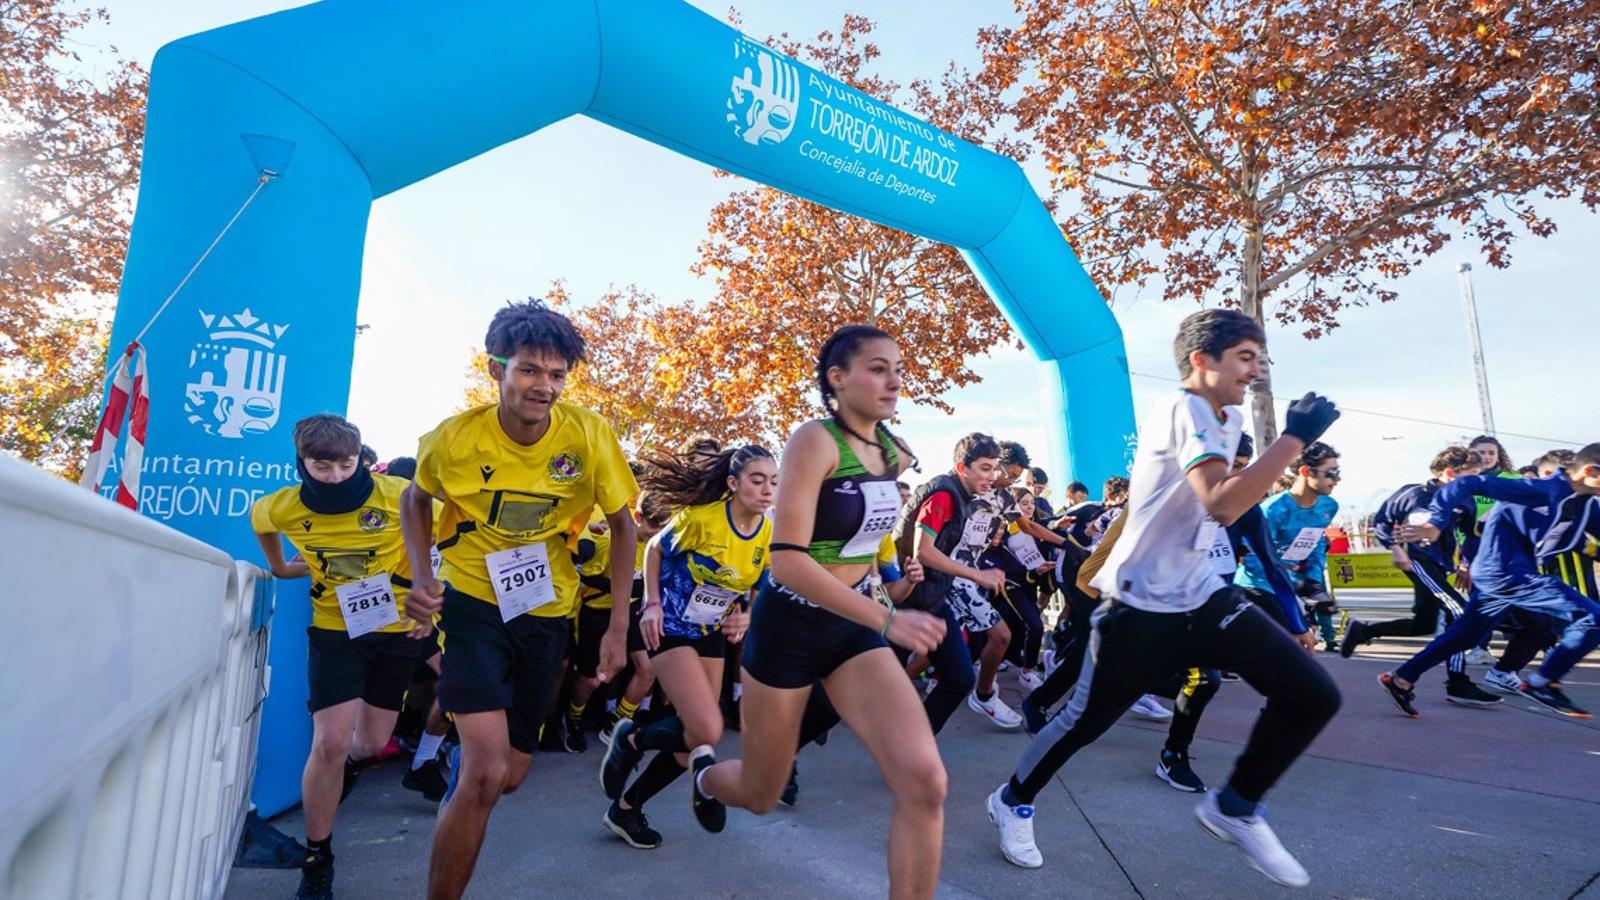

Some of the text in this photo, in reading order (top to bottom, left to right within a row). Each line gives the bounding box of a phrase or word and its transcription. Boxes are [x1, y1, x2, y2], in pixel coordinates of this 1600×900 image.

[809, 72, 958, 152] Ayuntamiento de
[809, 97, 960, 187] TORREJÓN DE ARDOZ
[799, 139, 937, 205] Concejalía de Deportes
[500, 563, 547, 593] 7907
[694, 593, 728, 607] 6616
[347, 592, 392, 613] 7814
